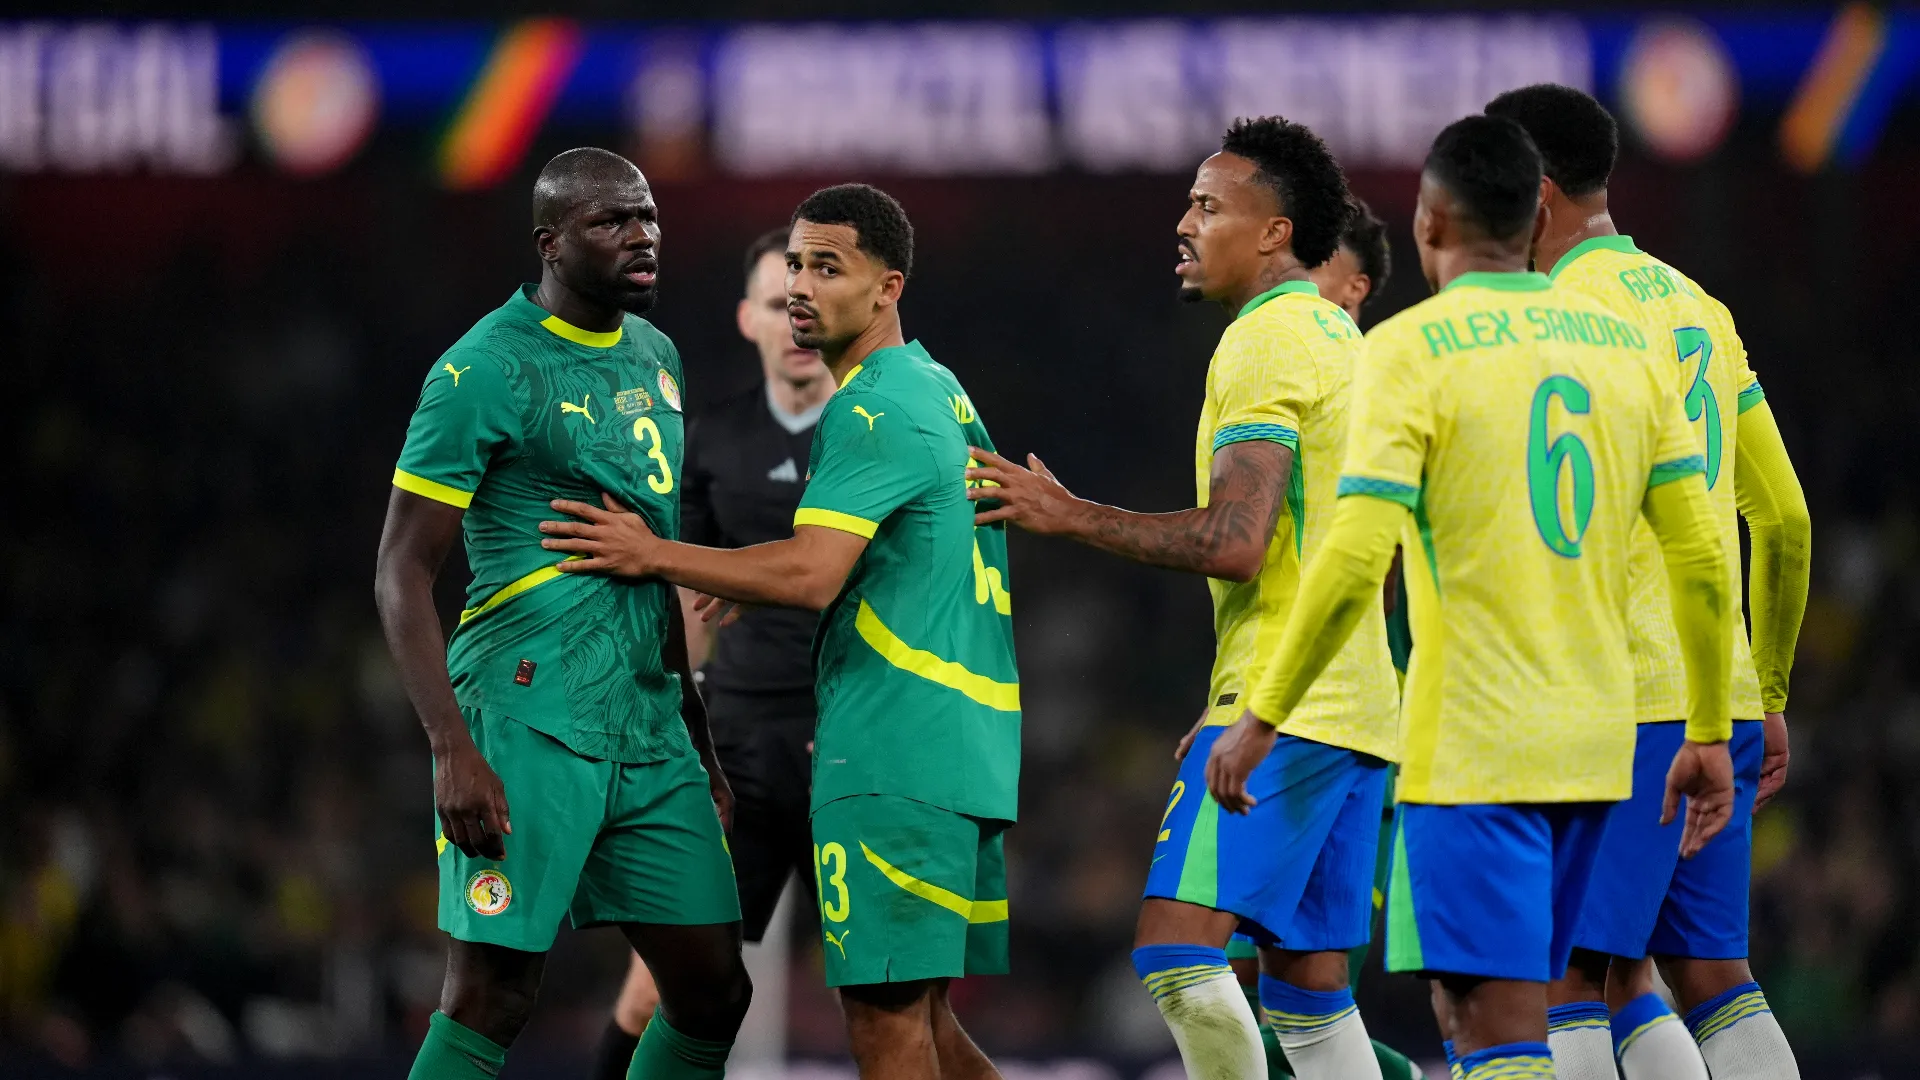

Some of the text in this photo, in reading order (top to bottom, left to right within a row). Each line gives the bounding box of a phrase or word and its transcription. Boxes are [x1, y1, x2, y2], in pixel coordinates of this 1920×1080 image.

[1420, 306, 1648, 358] ALEX SANDRO
[633, 416, 674, 495] 3
[1527, 374, 1595, 559] 6
[1673, 326, 1722, 491] 3
